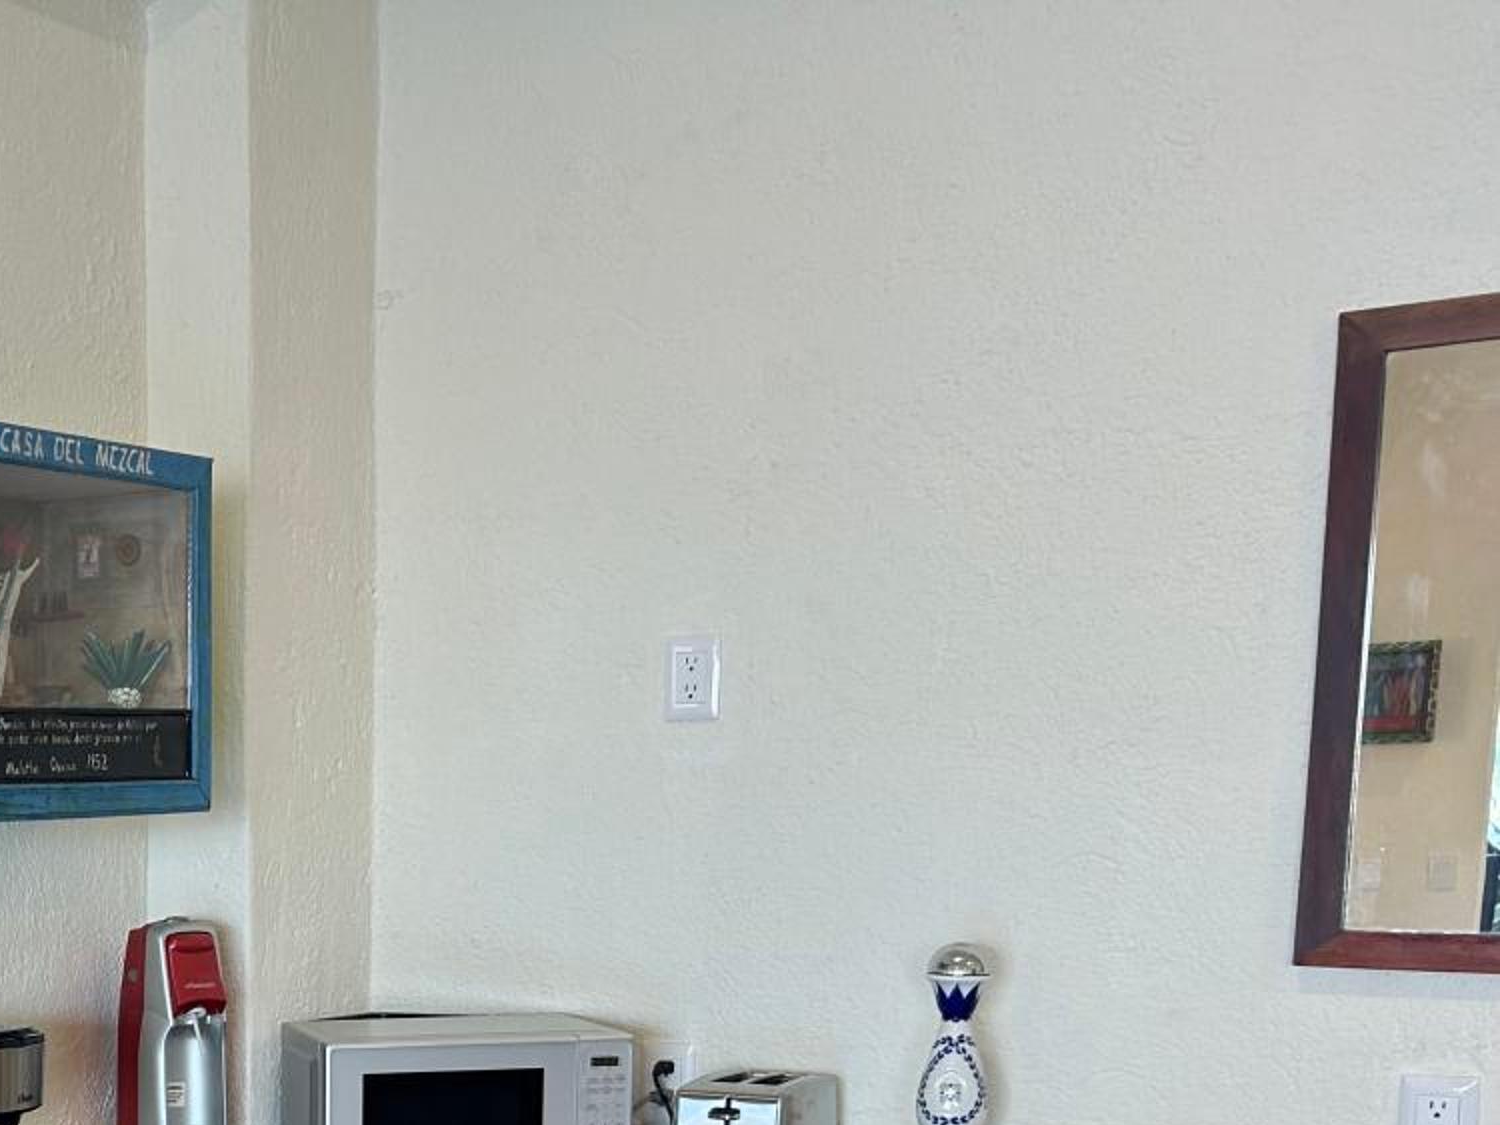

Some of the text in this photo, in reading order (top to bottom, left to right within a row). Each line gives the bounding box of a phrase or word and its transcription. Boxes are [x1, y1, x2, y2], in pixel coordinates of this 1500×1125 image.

[0, 427, 45, 459] CASA
[54, 436, 85, 465] DEL
[95, 443, 154, 475] MEZCAL
